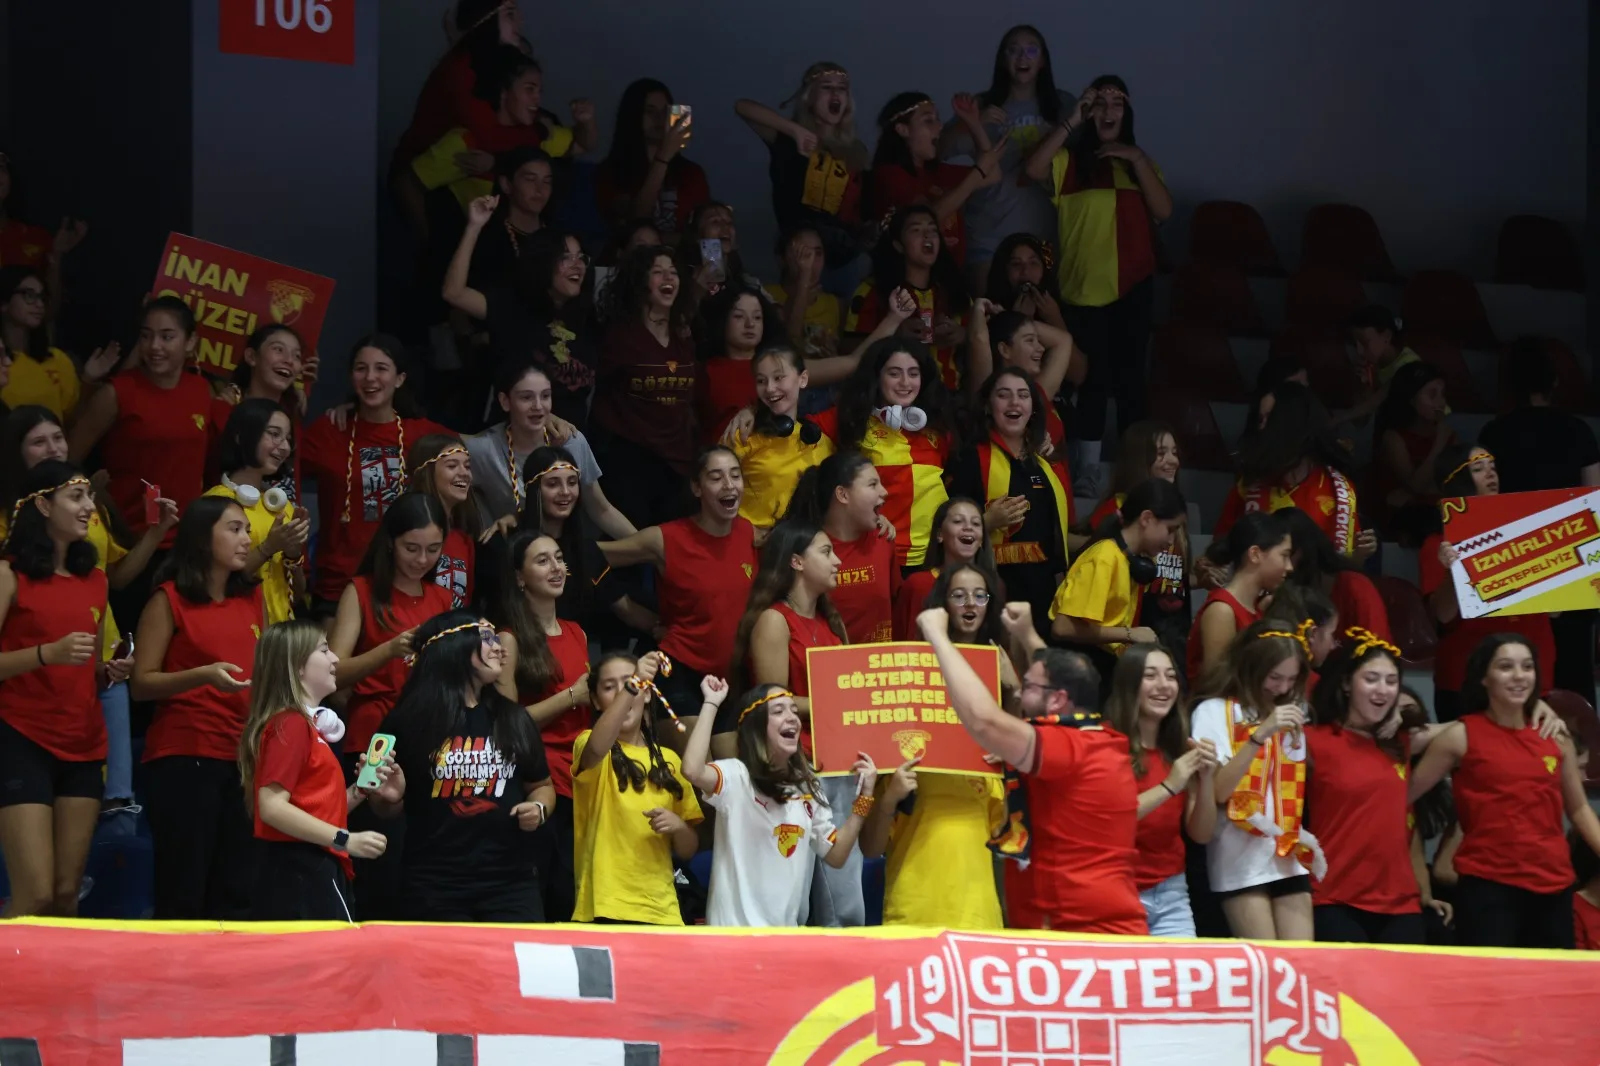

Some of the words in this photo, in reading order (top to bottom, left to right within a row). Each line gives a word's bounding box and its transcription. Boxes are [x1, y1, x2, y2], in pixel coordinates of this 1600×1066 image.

[255, 0, 333, 34] 106
[164, 245, 249, 297] İNAN
[1157, 550, 1183, 567] GÖZTE
[1472, 517, 1588, 573] İZMİRLİYİZ
[836, 570, 869, 585] 1925
[1482, 551, 1573, 594] GÖZTEPELİYİZ
[837, 671, 925, 689] GÖZTEPE
[871, 689, 946, 705] SADECE
[842, 707, 918, 726] FUTBOL
[921, 706, 963, 725] DEĞ
[969, 946, 1251, 1009] GÖZTEPE
